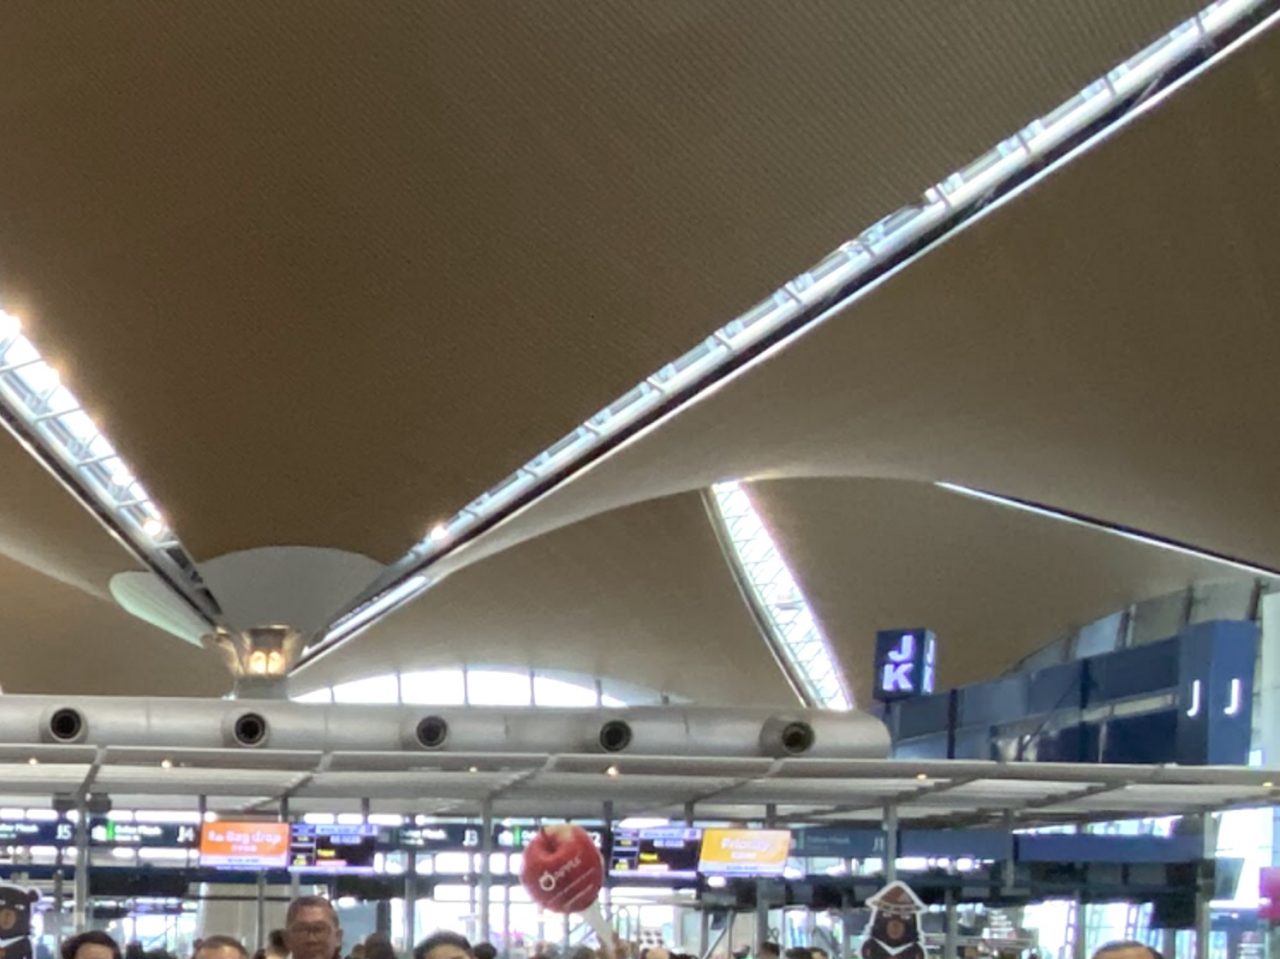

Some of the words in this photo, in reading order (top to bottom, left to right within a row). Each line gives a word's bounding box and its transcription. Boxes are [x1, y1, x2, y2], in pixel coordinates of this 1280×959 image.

[888, 635, 913, 661] J
[883, 663, 913, 690] K
[1187, 680, 1201, 717] J
[1224, 678, 1241, 715] J
[55, 824, 73, 840] J5
[176, 826, 195, 842] J4
